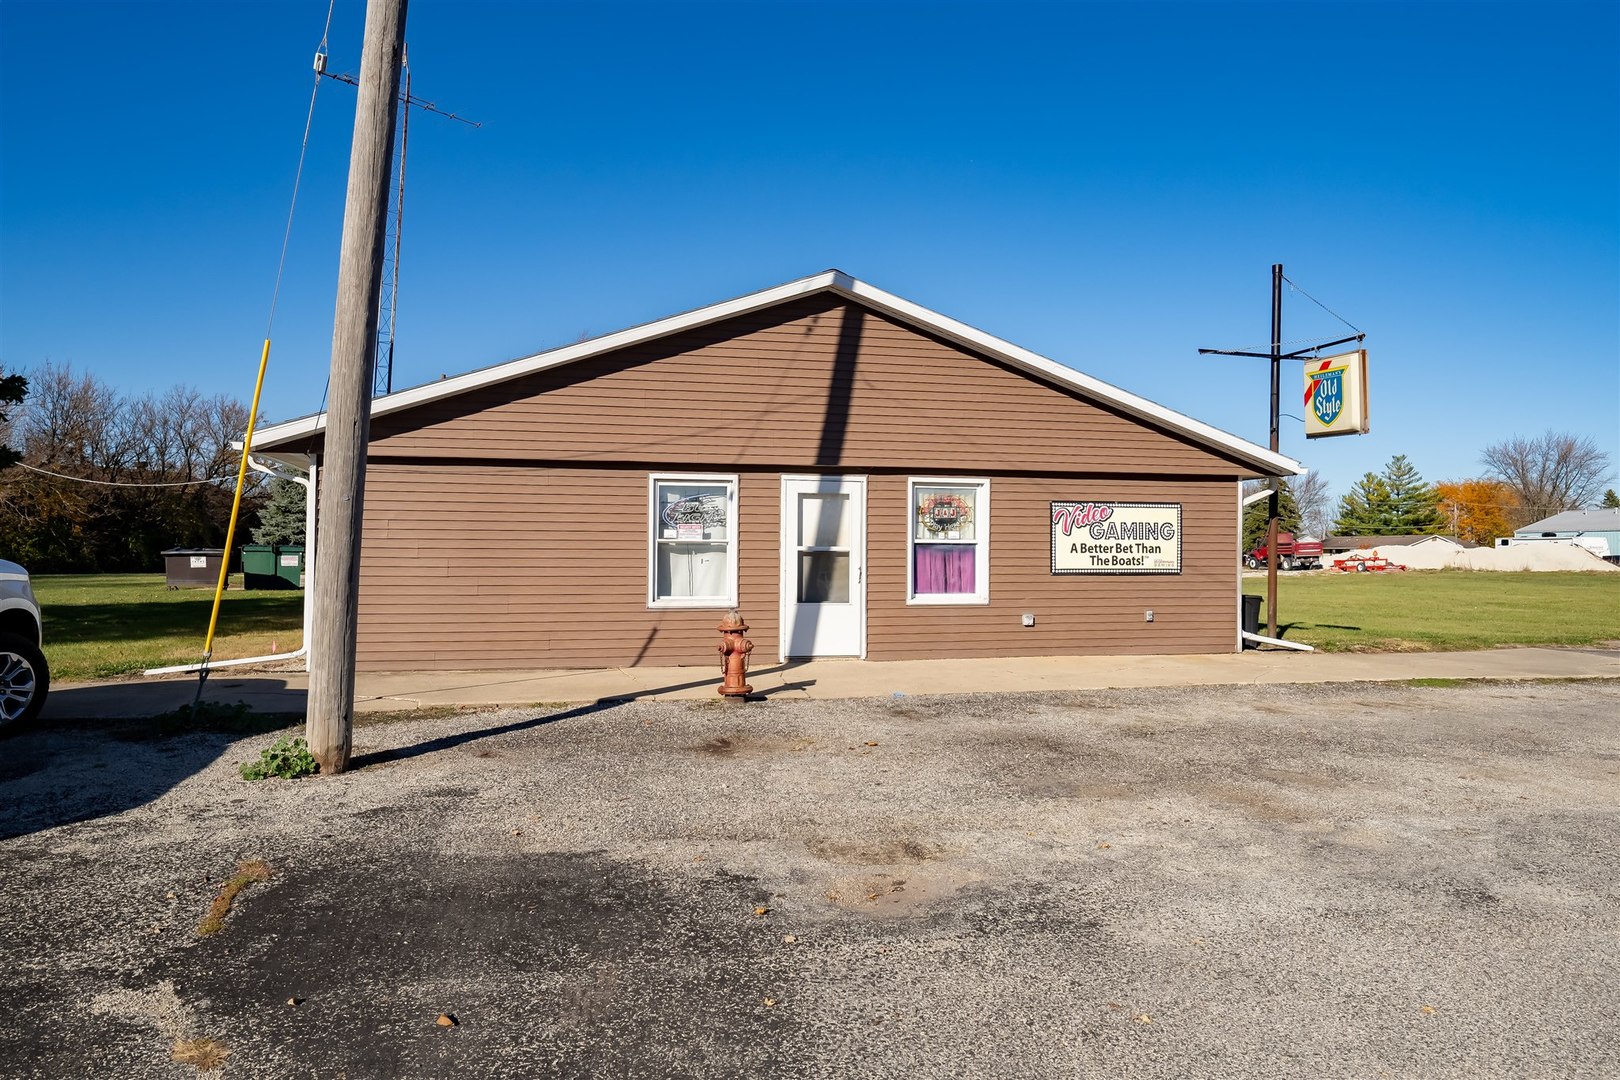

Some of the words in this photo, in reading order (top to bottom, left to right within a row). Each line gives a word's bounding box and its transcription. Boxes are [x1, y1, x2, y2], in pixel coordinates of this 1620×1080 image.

[1320, 378, 1337, 398] Old
[1316, 397, 1341, 421] Style
[1053, 503, 1113, 535] Video
[1089, 522, 1175, 541] GAMING
[1070, 543, 1078, 554] A
[1081, 543, 1114, 554] Better
[1115, 543, 1133, 554] Bet
[1135, 543, 1161, 555] Than
[1090, 555, 1110, 566] The
[1111, 555, 1145, 567] Boats!
